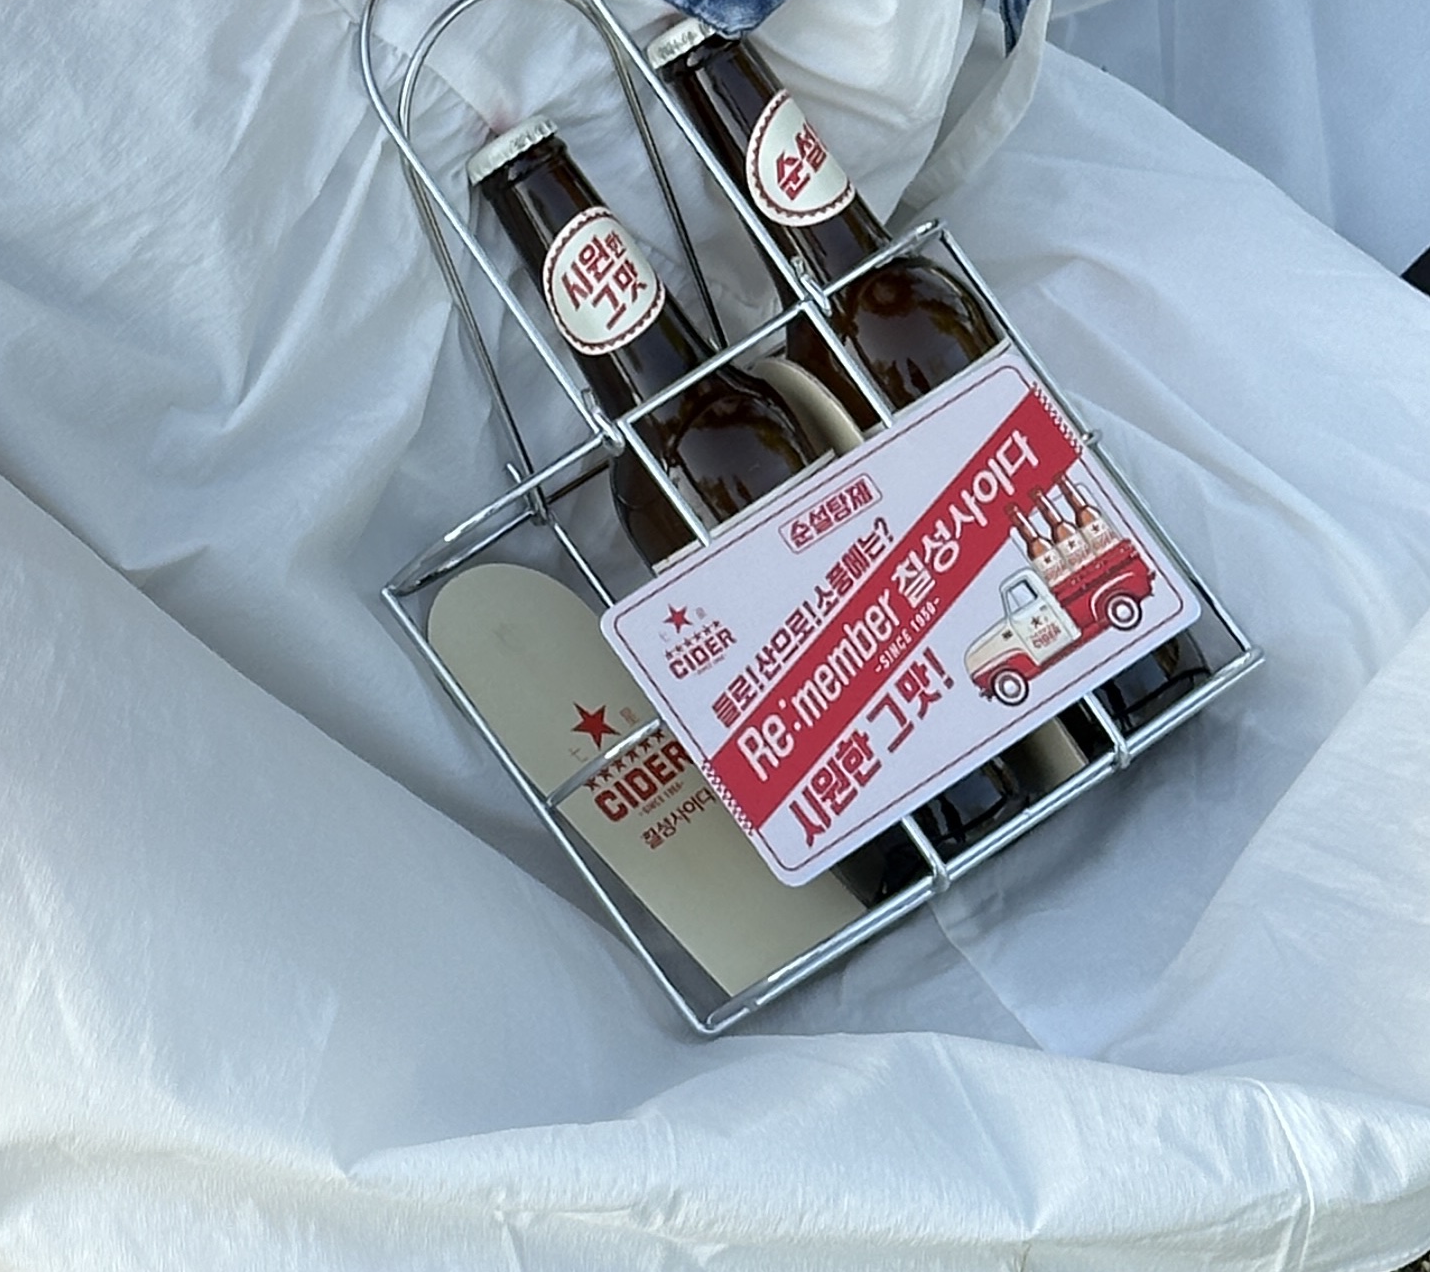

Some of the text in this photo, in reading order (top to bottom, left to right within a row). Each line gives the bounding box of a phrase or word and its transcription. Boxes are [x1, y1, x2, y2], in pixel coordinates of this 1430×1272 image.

[561, 230, 627, 312] 시원한
[790, 479, 873, 548] 순설탕제
[737, 430, 1039, 781] Re:member 칠성사이다
[668, 628, 738, 680] CIDER
[594, 740, 694, 823] CIDER
[789, 729, 882, 847] 시원한
